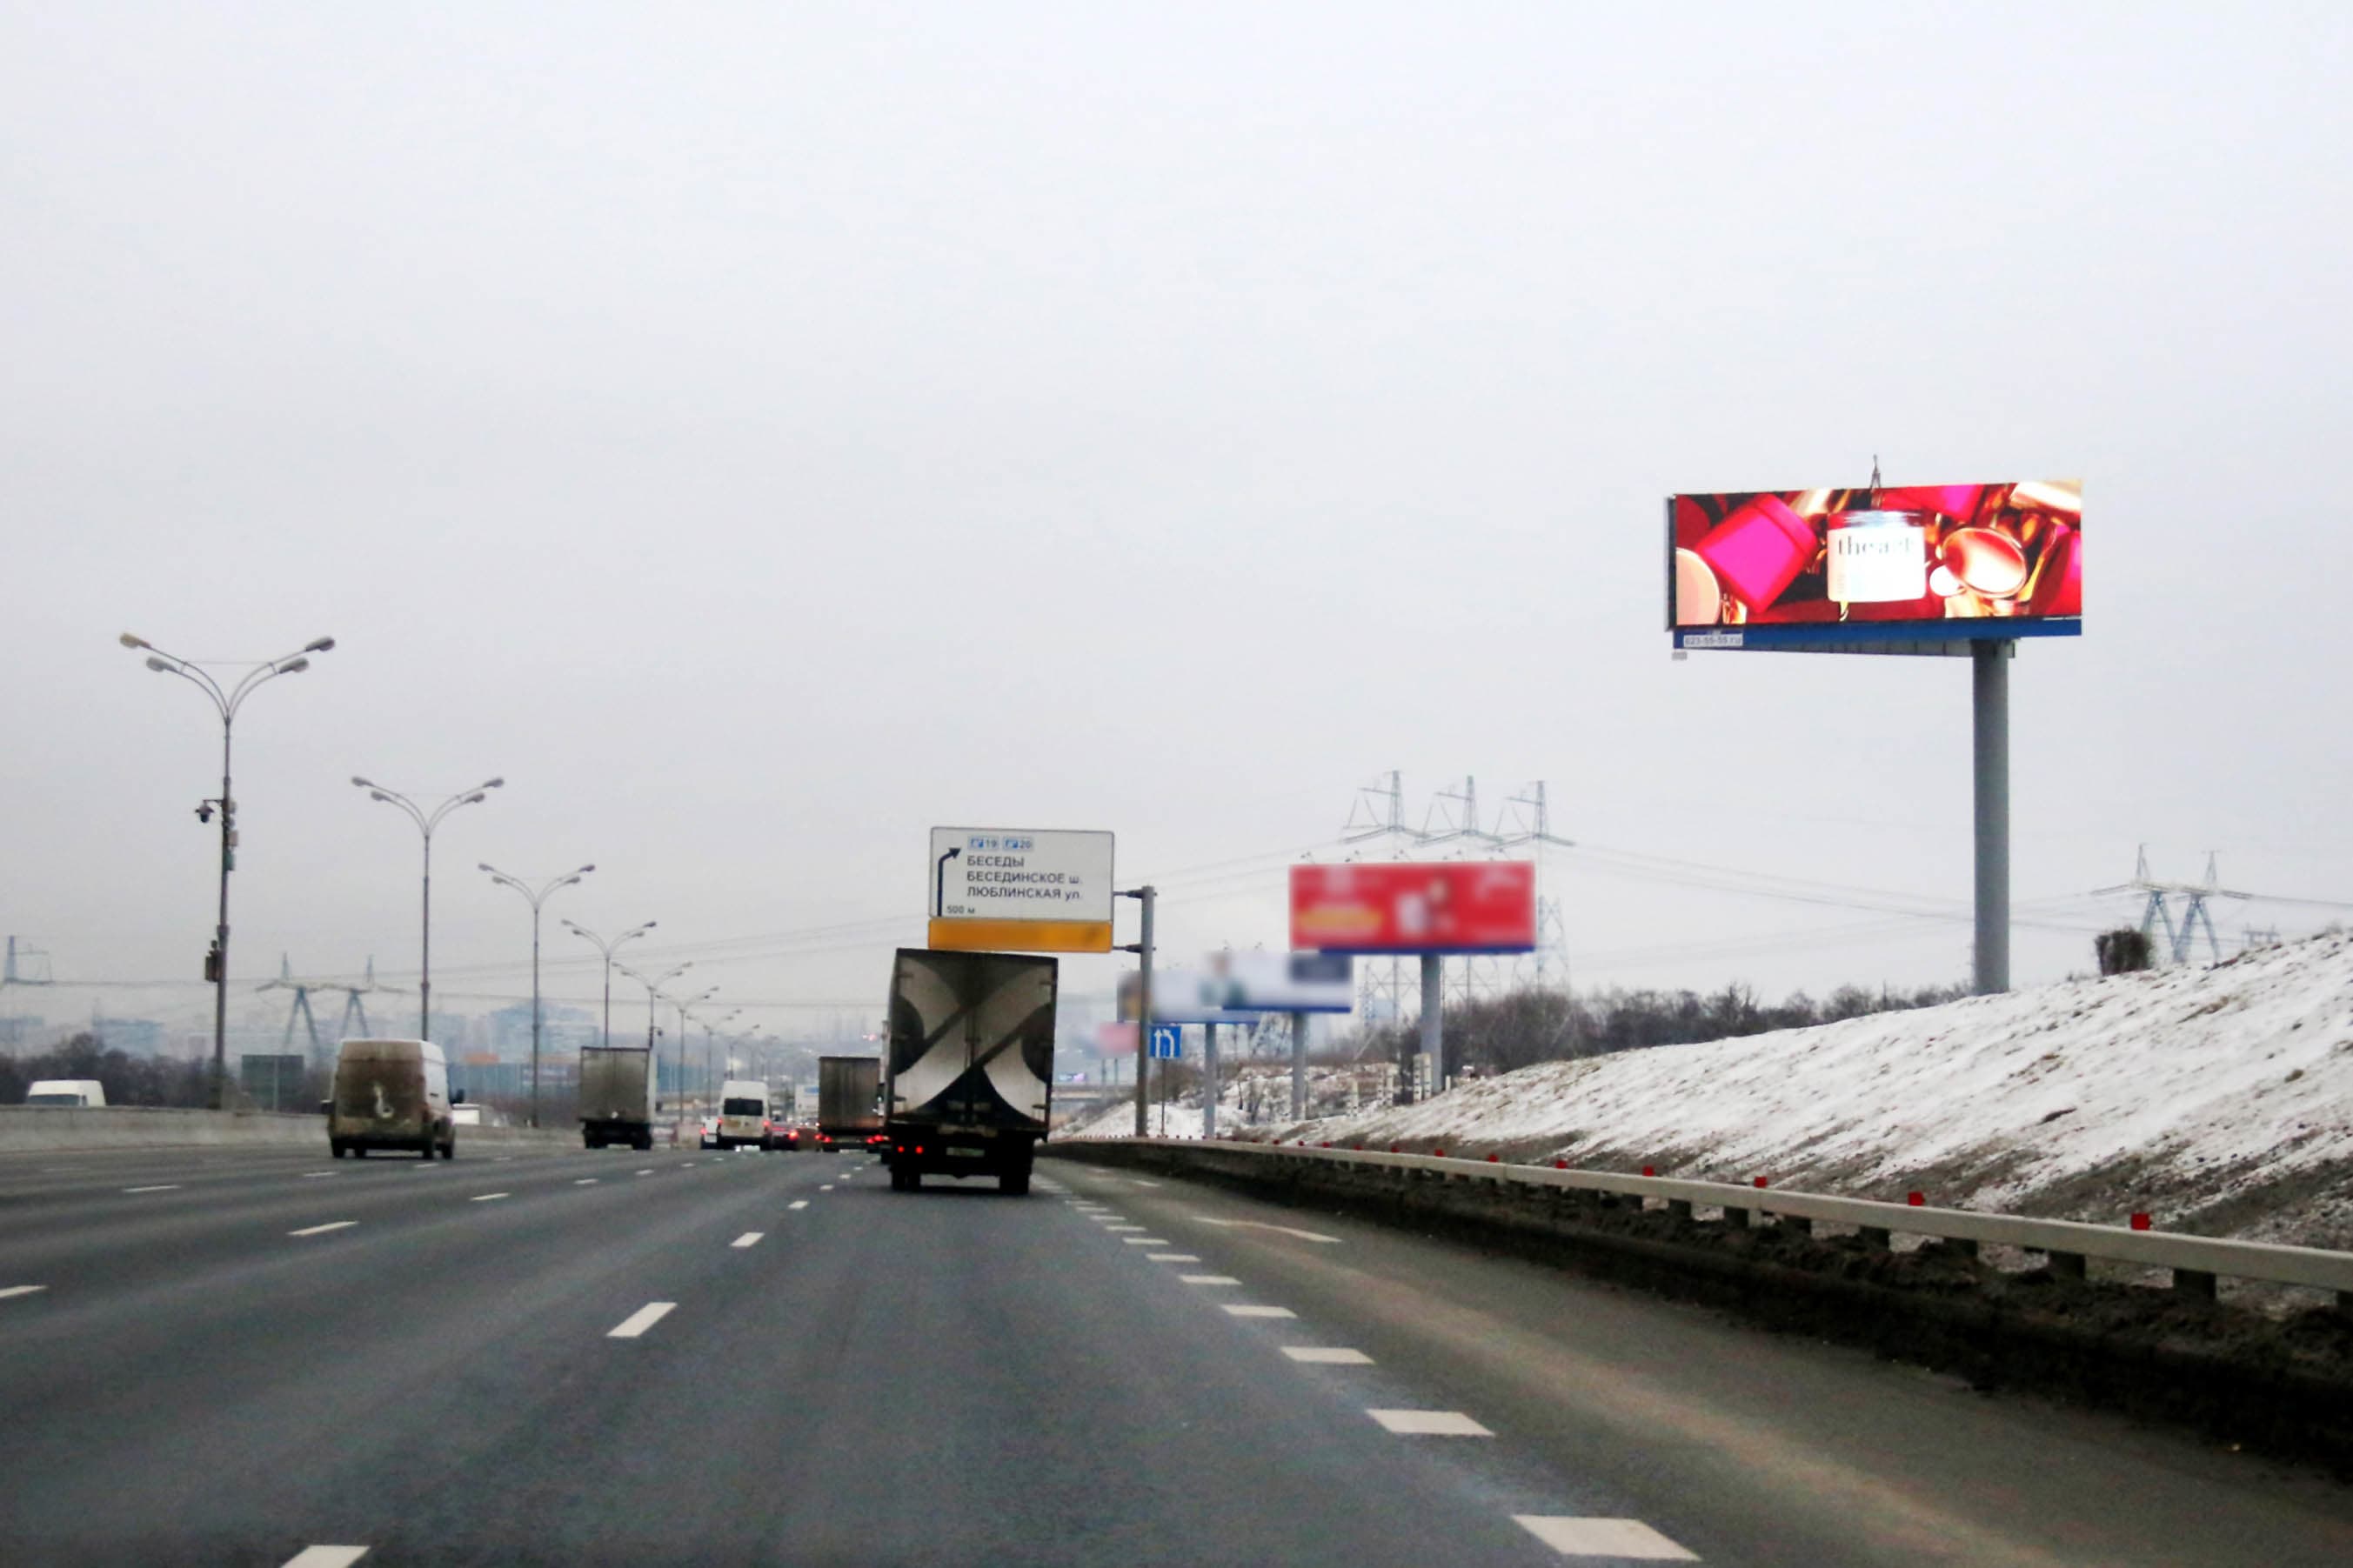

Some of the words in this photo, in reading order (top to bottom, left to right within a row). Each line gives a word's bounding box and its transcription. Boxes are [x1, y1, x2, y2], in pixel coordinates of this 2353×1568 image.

[966, 855, 1025, 868] БЕСЕДЫ
[966, 871, 1066, 884] БЕСЕДИНСКОЕ
[966, 885, 1061, 899] ЛЮБЛИНСКАЯ
[946, 905, 965, 914] 500
